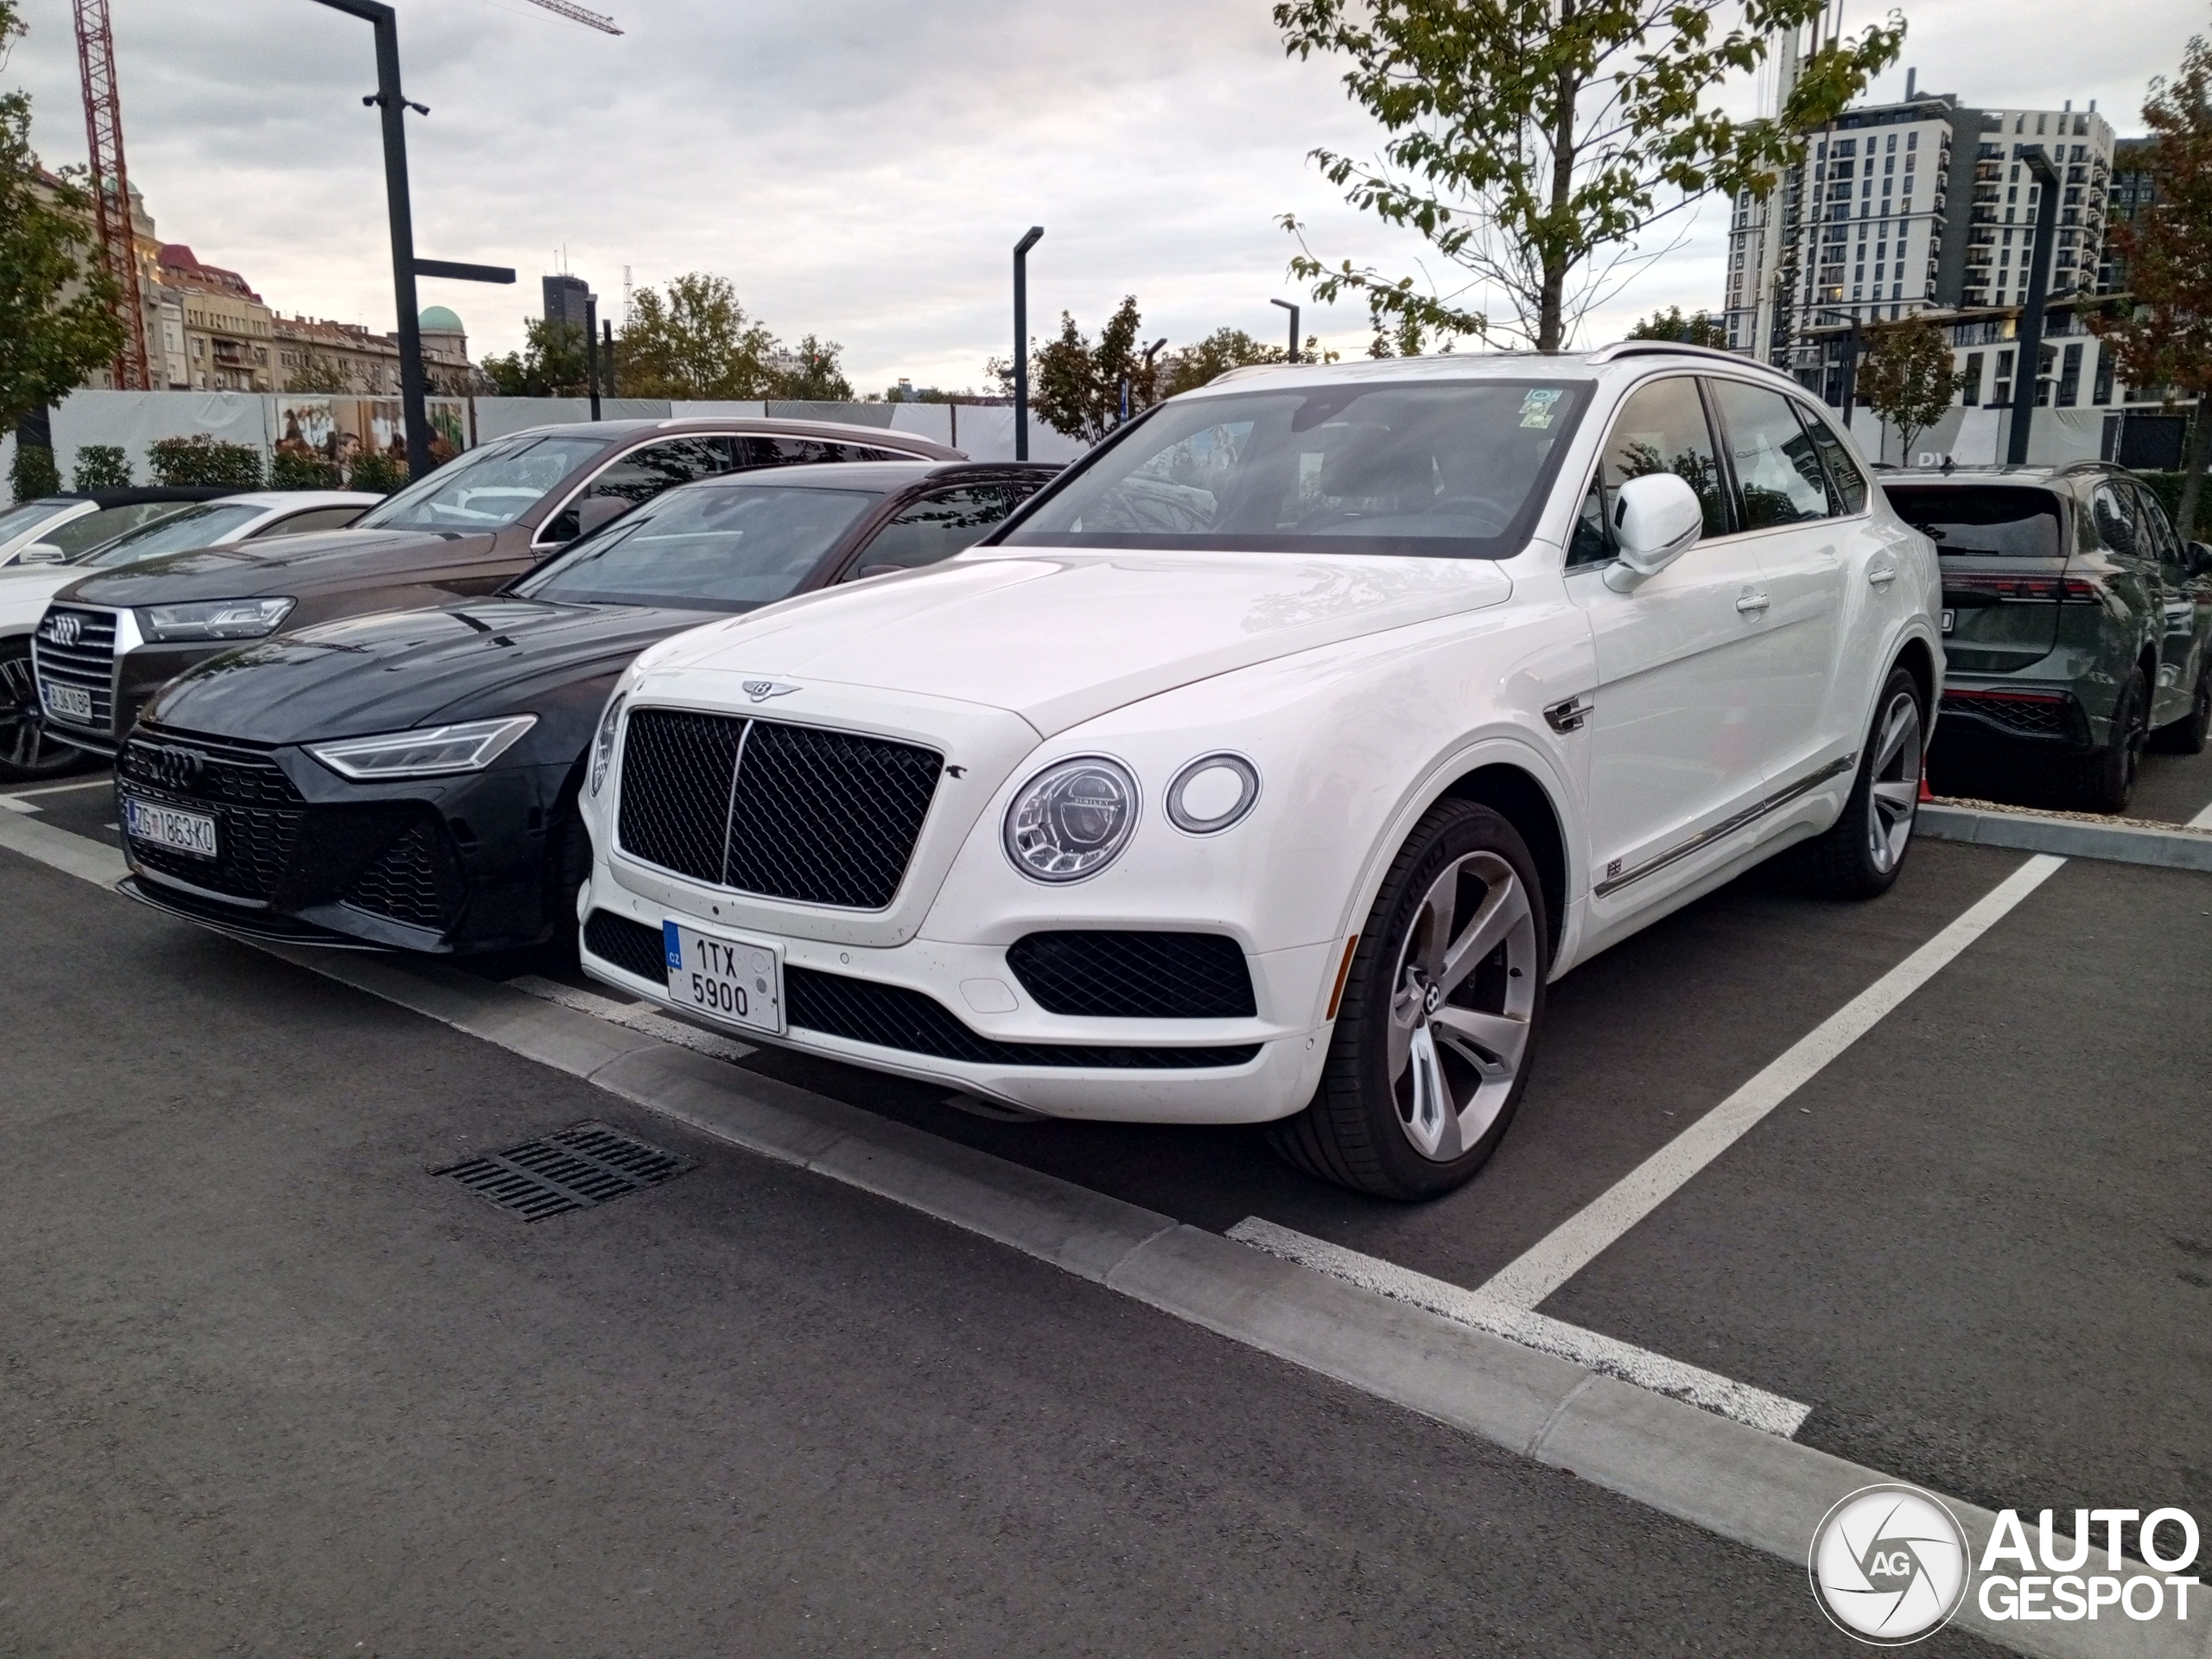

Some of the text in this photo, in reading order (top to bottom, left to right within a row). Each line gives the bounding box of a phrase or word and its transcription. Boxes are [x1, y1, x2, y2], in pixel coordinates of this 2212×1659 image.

[669, 951, 681, 965] CZ
[696, 938, 737, 979] 1TX
[691, 972, 748, 1017] 5900
